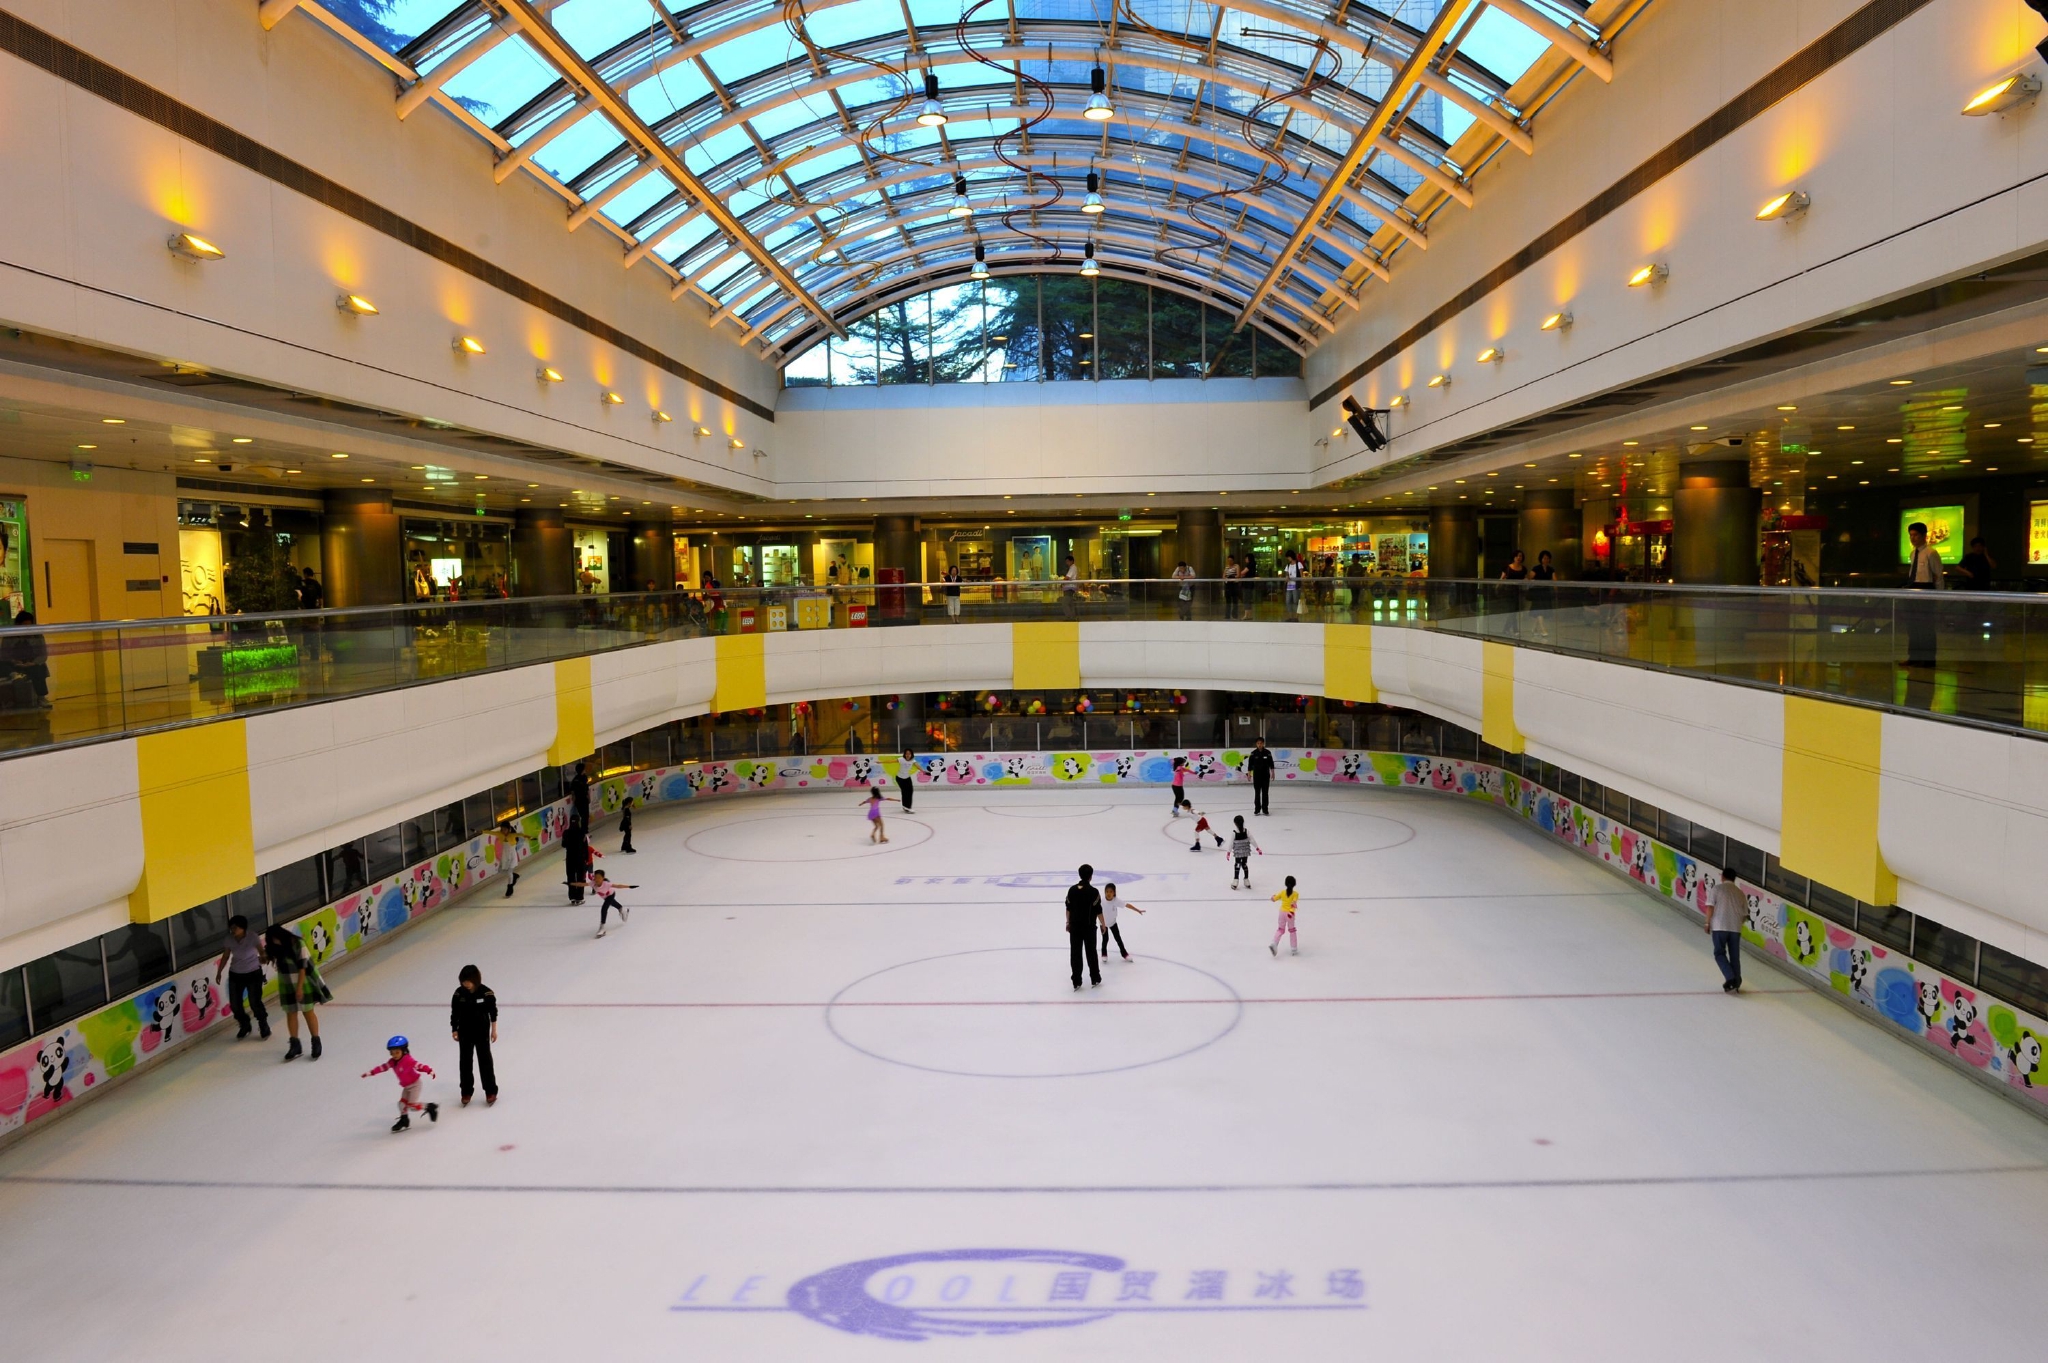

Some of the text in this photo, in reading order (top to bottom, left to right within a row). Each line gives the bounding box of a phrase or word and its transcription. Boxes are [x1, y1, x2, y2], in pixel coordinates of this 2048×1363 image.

[2034, 518, 2048, 528] 海鲜
[2034, 530, 2048, 539] 老火
[851, 612, 866, 620] LEGO
[743, 617, 754, 625] LEGO
[681, 1273, 768, 1302] LE
[1047, 1268, 1366, 1302] 国贸溜冰场
